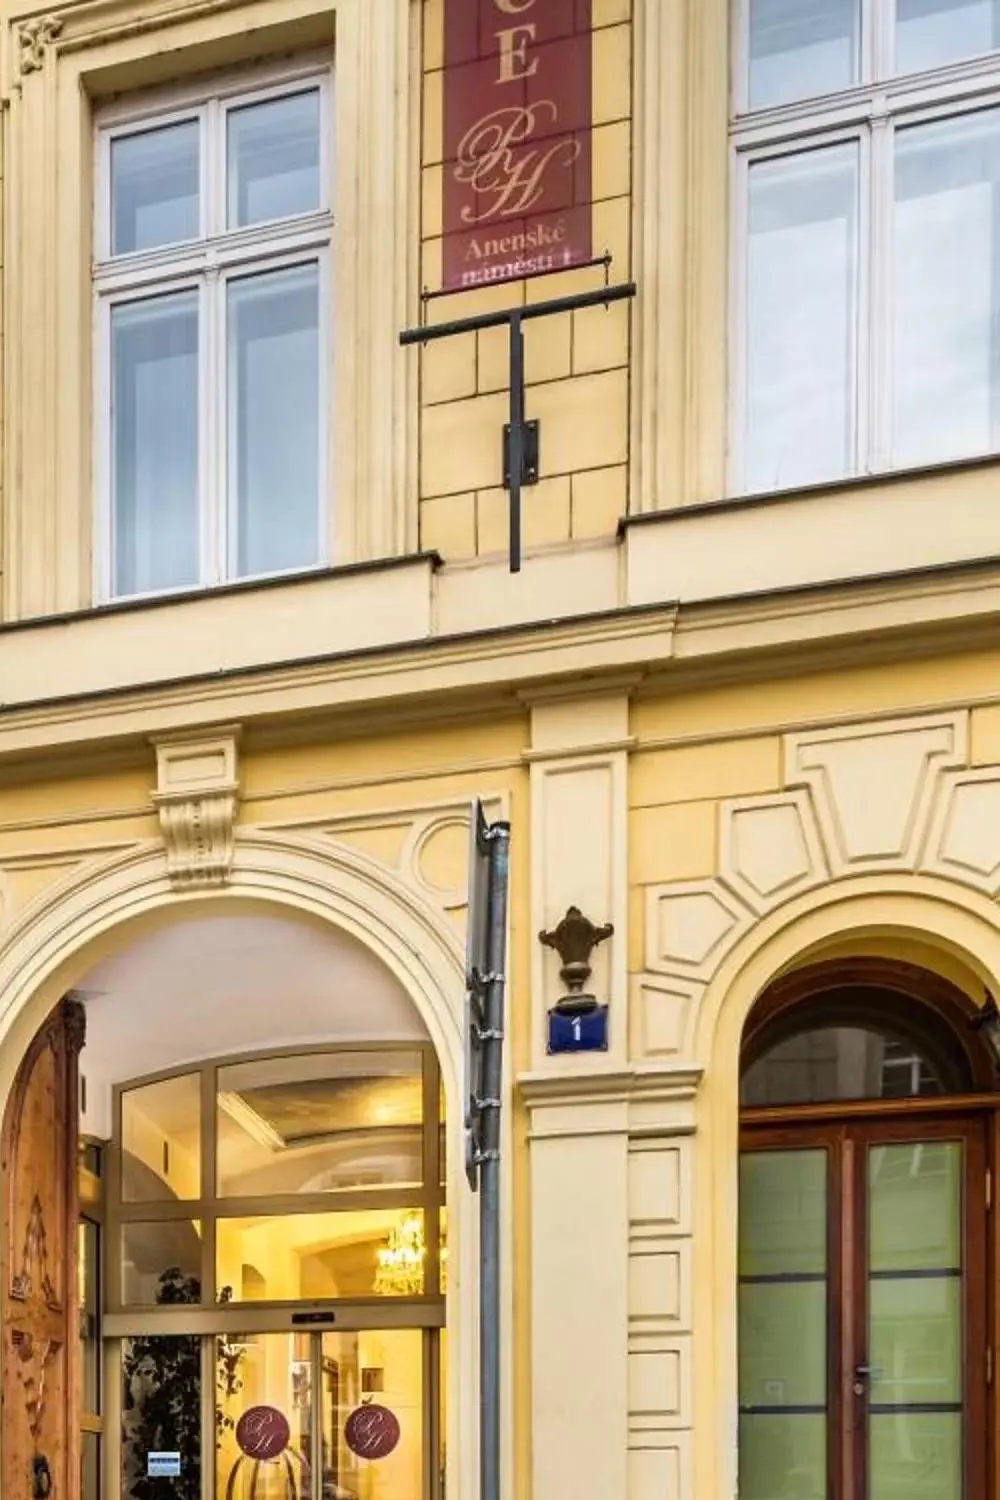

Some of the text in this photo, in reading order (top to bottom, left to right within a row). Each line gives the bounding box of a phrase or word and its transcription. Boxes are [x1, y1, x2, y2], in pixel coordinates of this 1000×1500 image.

[492, 0, 540, 85] E
[466, 219, 566, 262] Anenské
[571, 1016, 581, 1041] 1
